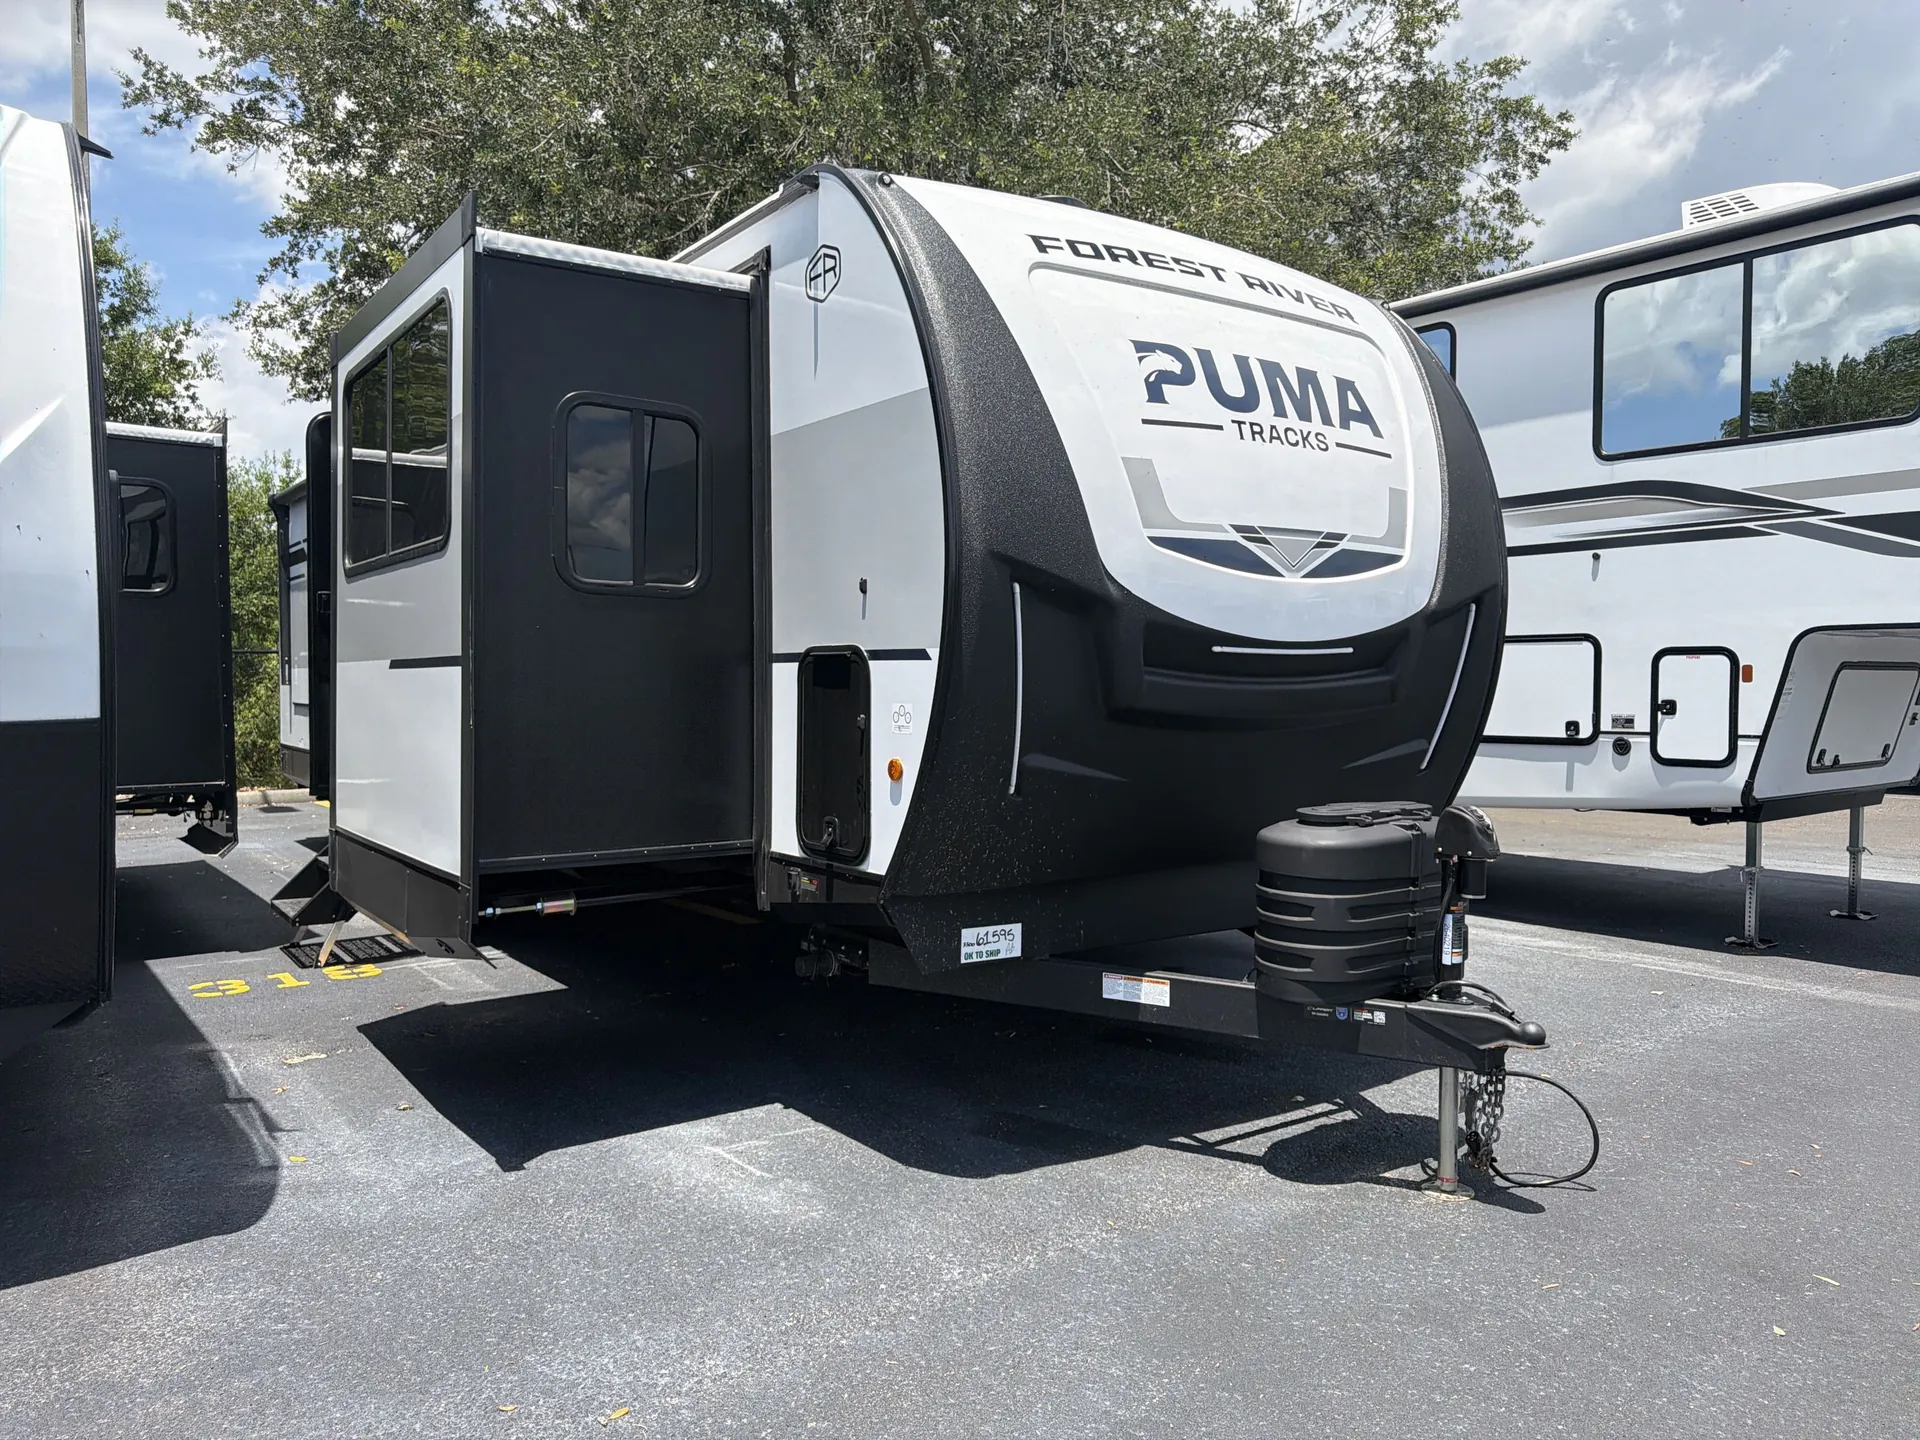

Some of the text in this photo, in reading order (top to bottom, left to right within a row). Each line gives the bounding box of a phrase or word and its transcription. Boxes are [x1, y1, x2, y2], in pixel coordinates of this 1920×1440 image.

[1025, 233, 1360, 326] FOREST RIVER
[1128, 338, 1385, 440] PUMA
[1230, 418, 1330, 453] TRACKS
[964, 948, 1001, 961] OK TO SHIP
[976, 929, 1015, 946] 61595
